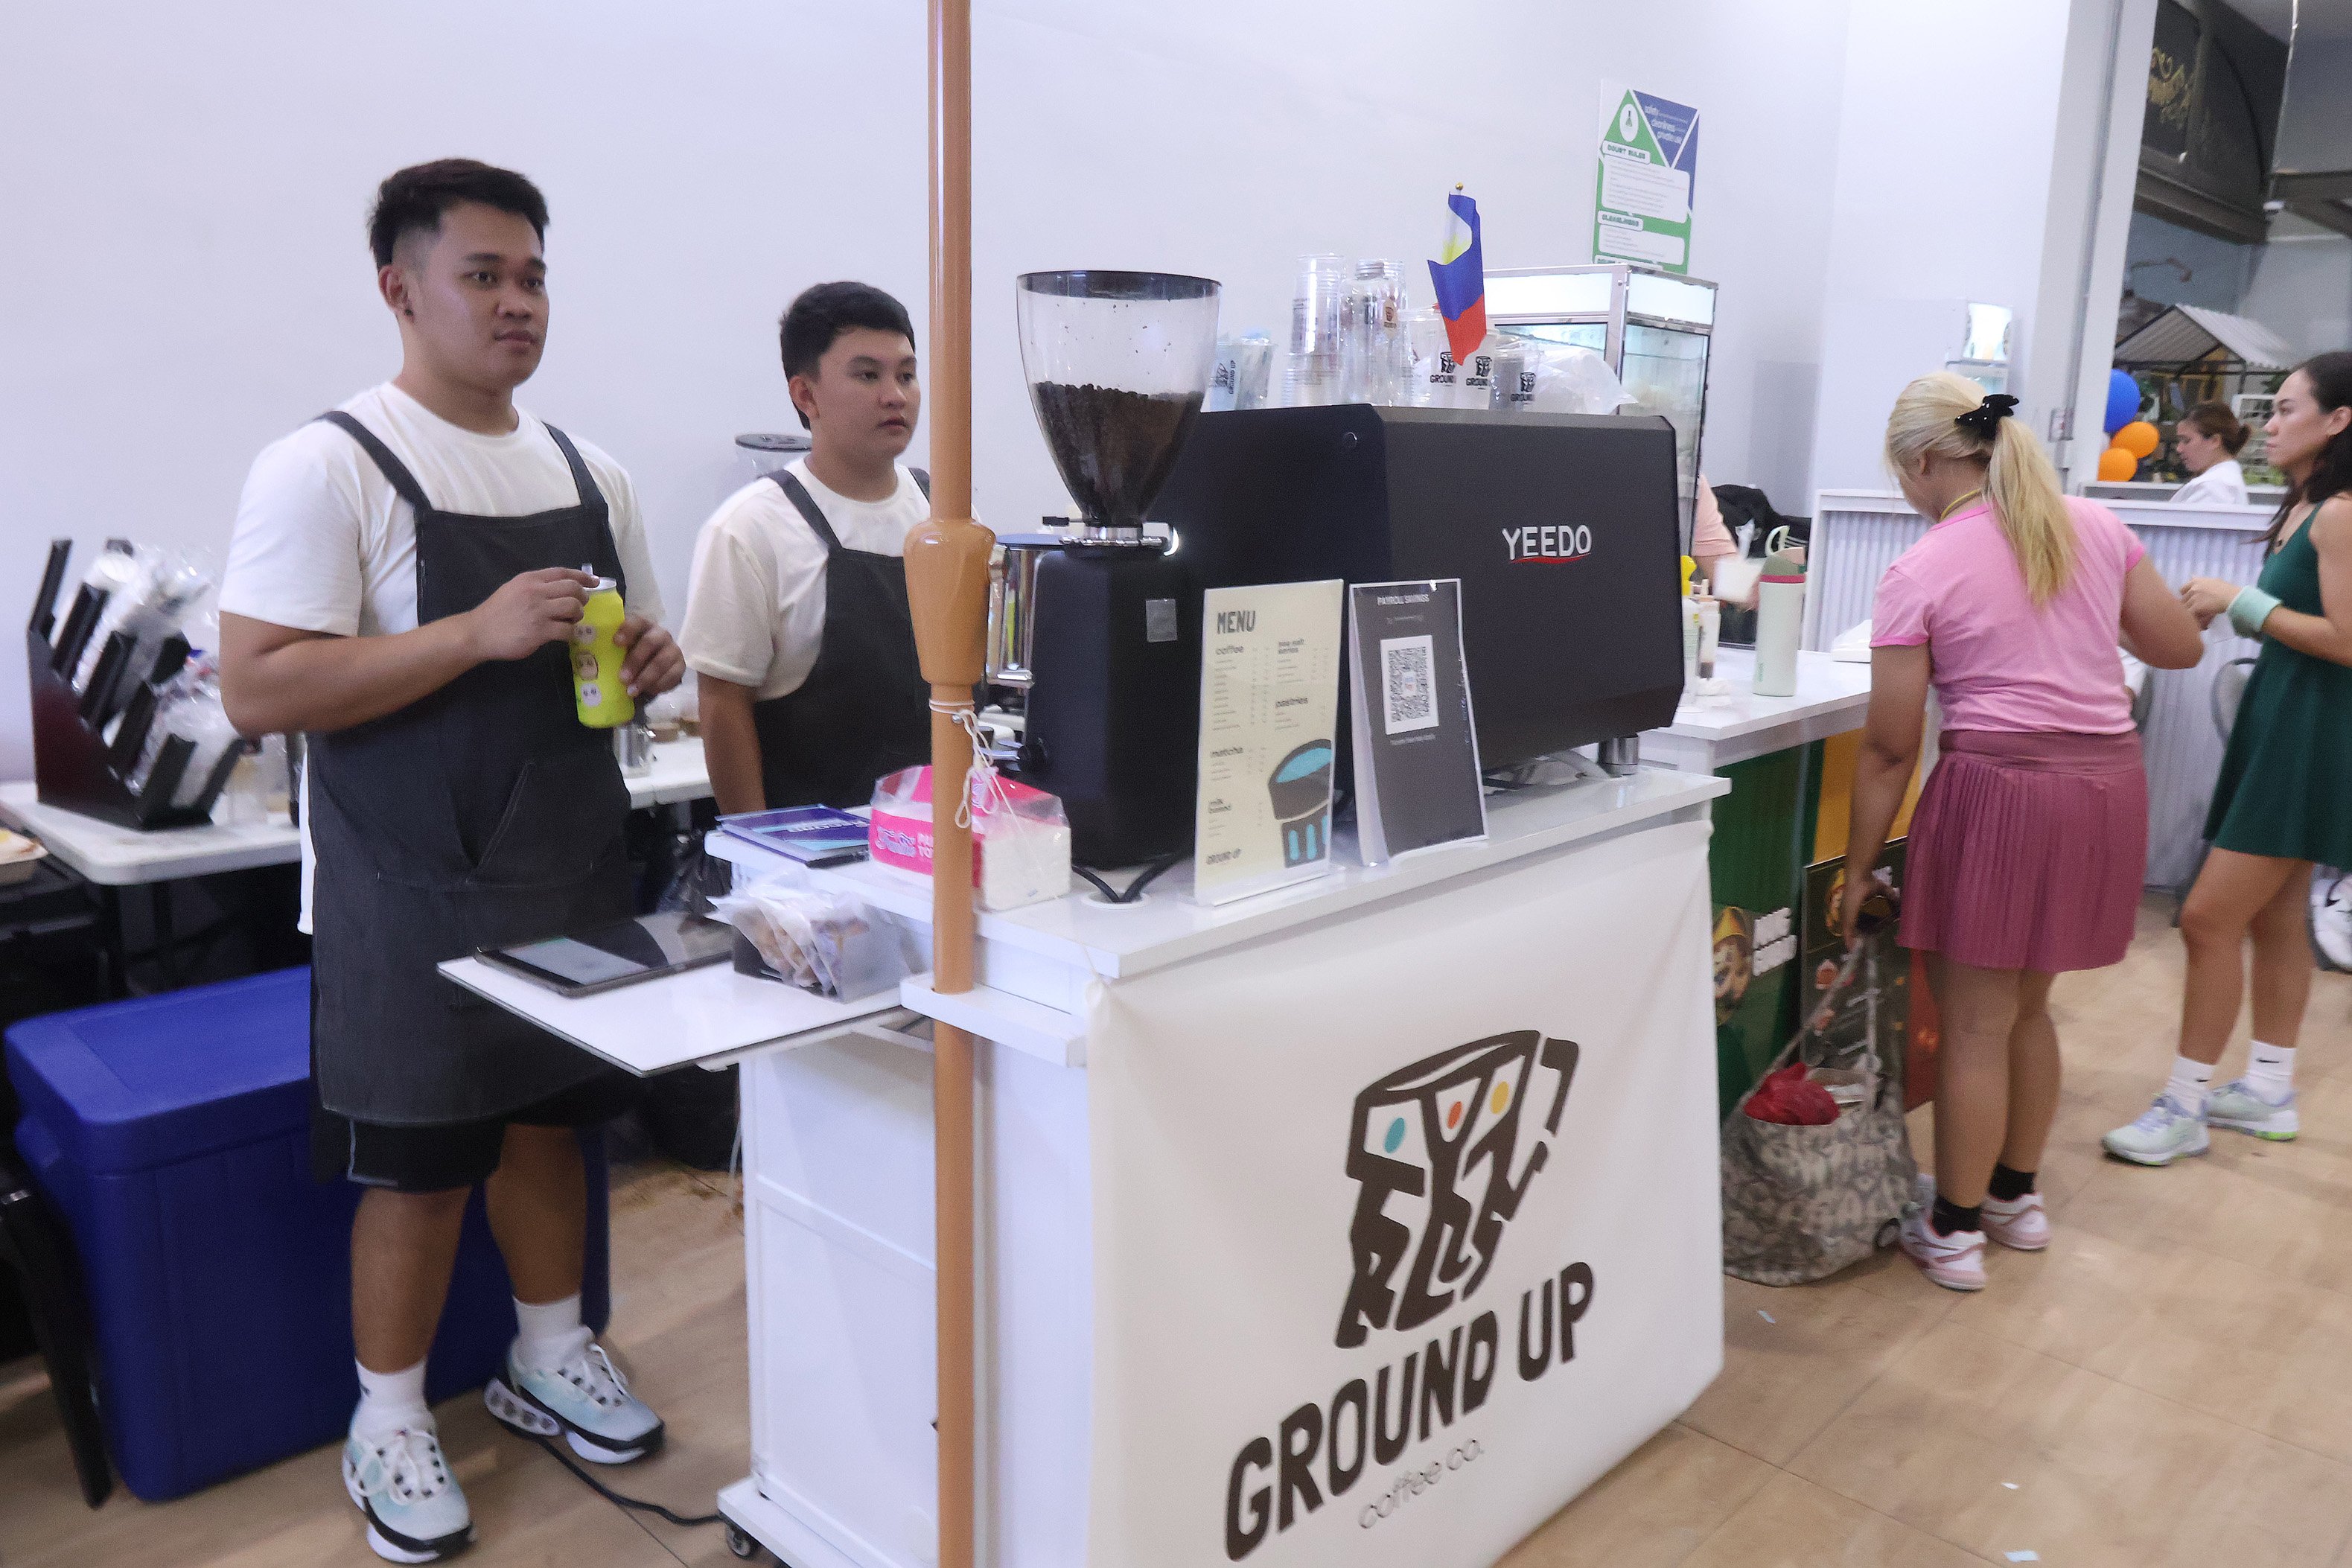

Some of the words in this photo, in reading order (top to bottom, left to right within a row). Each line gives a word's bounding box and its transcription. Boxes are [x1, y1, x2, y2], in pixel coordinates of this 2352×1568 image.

[1501, 524, 1593, 561] YEEDO
[1217, 610, 1256, 634] MENU
[1225, 1310, 1499, 1562] GROUND
[1516, 1261, 1594, 1383] UP
[1357, 1461, 1443, 1529] coffee
